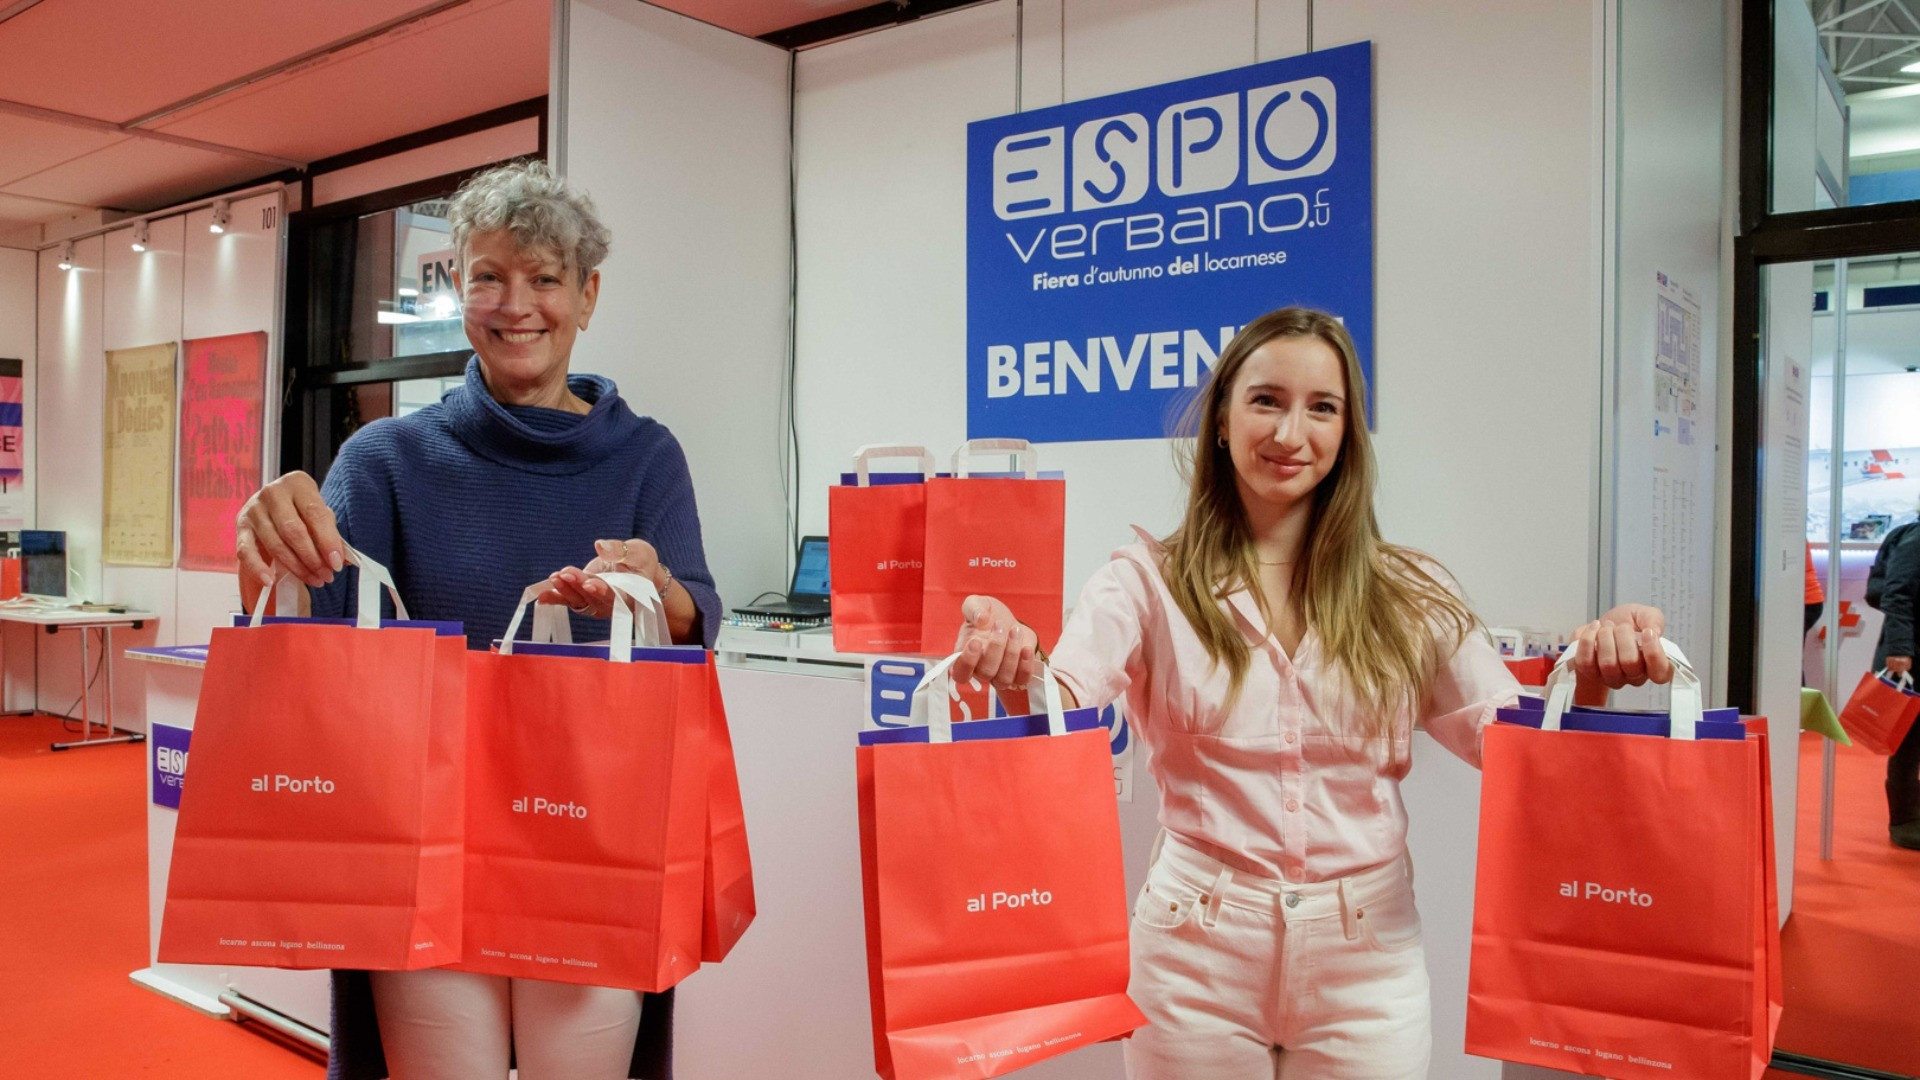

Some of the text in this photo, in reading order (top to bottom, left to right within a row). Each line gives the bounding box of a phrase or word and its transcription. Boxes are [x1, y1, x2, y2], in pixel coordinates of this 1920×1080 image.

[993, 76, 1336, 220] ESPO
[262, 206, 276, 230] 101
[1033, 251, 1287, 291] Fiera d'autunno del locarnese
[117, 397, 164, 433] Bodies
[877, 560, 922, 570] al Porto
[968, 557, 1016, 568] al Porto
[251, 774, 335, 794] al Porto
[512, 797, 587, 819] al Porto
[967, 888, 1052, 912] al Porto
[1559, 880, 1653, 907] al Porto
[219, 937, 247, 946] locarno
[307, 941, 345, 950] bellinzona
[481, 947, 506, 958] locarno
[562, 957, 598, 968] bellinzona
[957, 1053, 986, 1064] locarno
[989, 1048, 1014, 1059] ascona
[1016, 1043, 1041, 1053] lugano
[1529, 1036, 1672, 1069] locarno ascona lugano bellinzona
